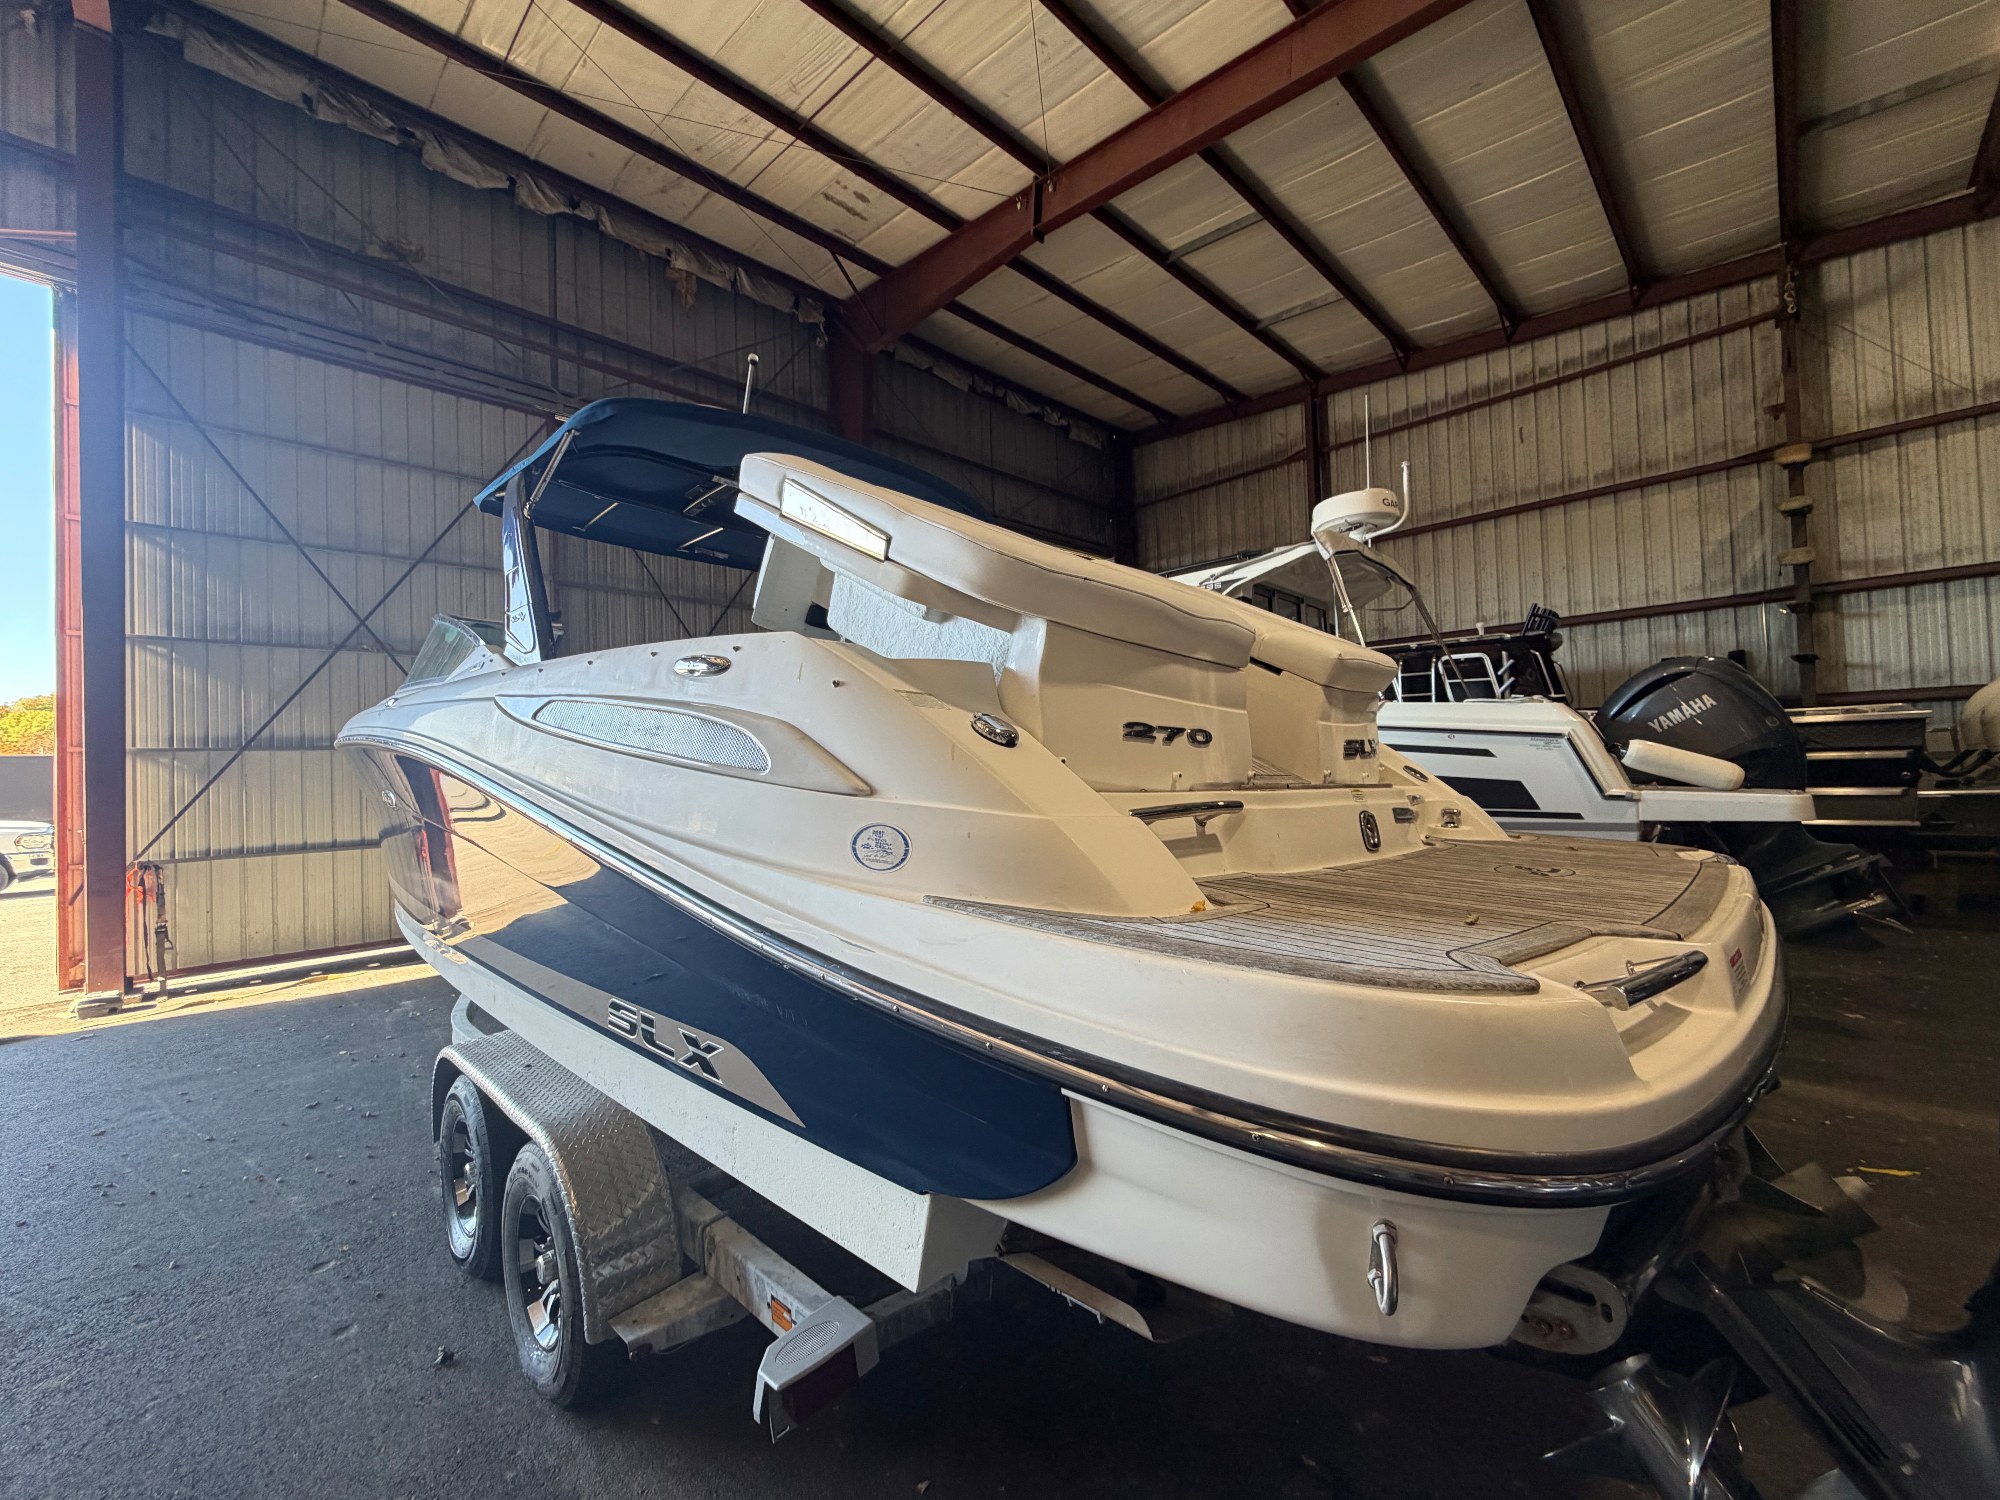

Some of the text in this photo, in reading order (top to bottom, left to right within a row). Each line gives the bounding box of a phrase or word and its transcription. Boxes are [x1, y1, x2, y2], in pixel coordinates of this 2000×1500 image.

[1647, 693, 1718, 733] YAMAHA
[1122, 721, 1213, 746] 270
[607, 998, 725, 1085] SLX
